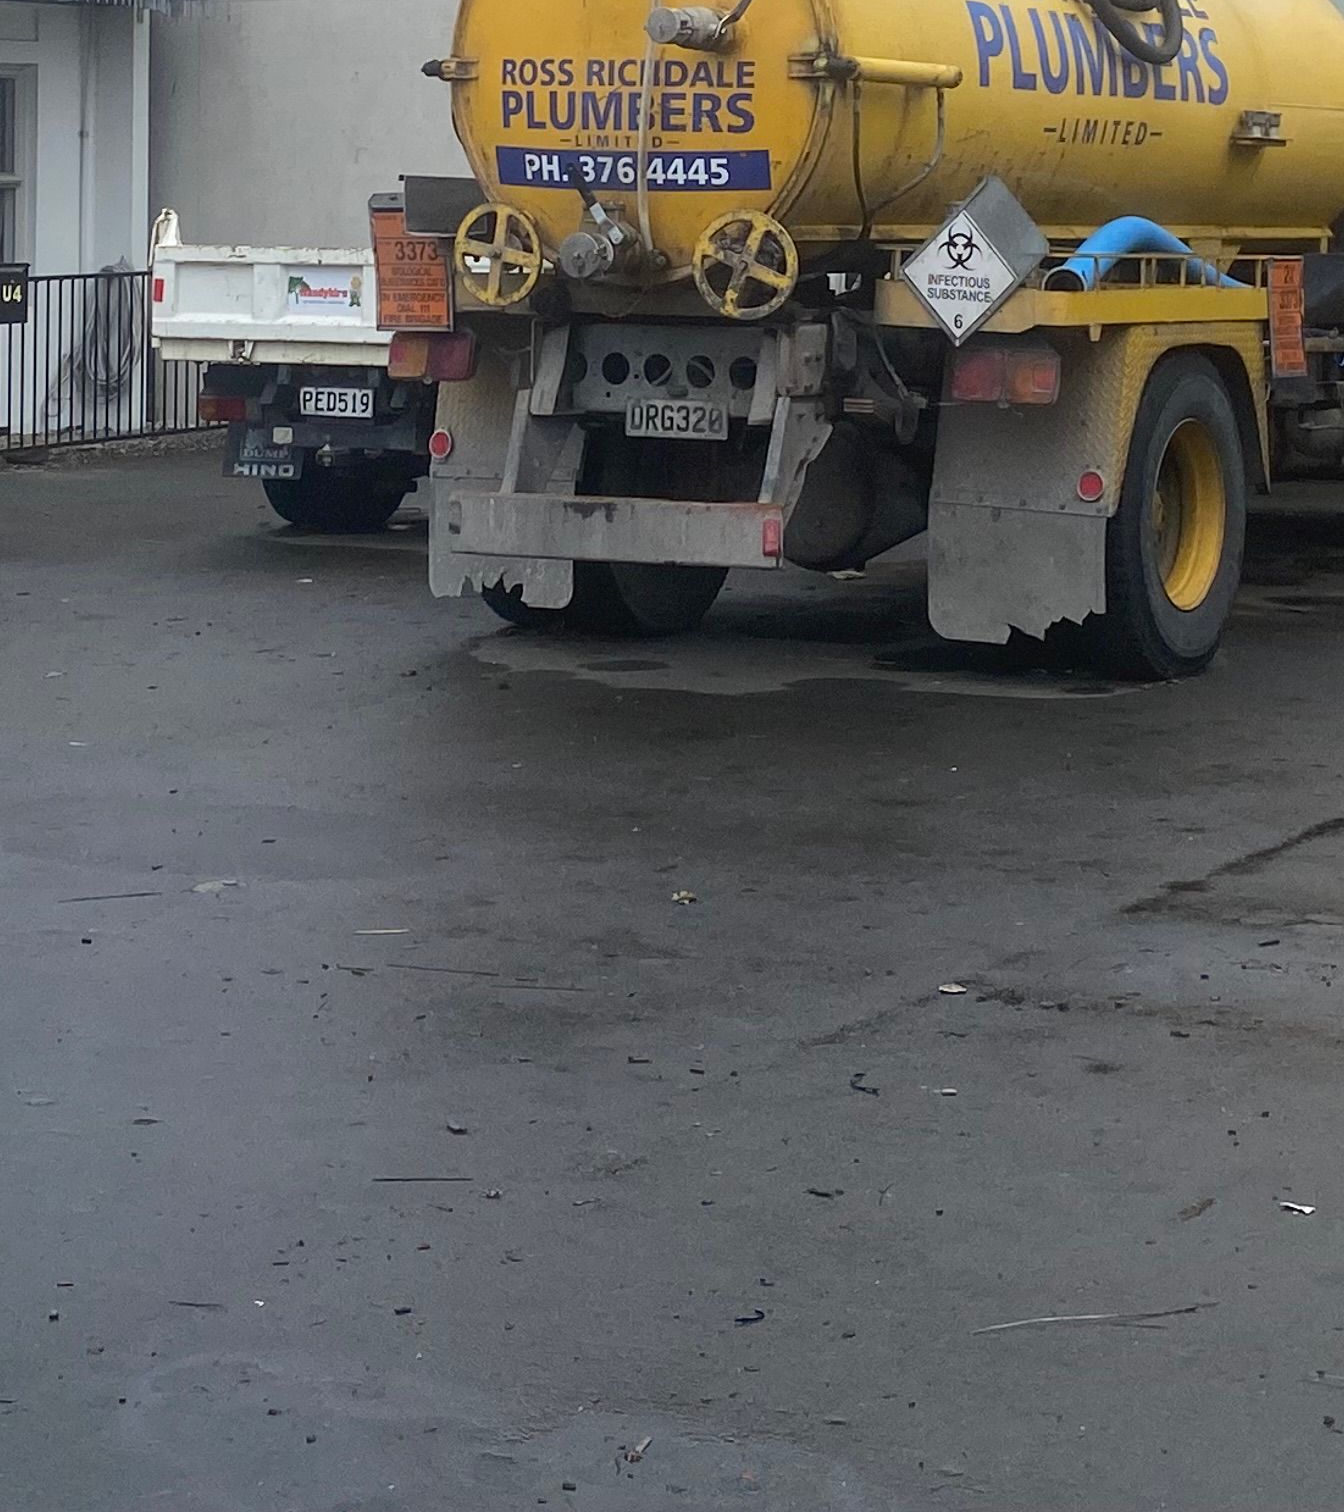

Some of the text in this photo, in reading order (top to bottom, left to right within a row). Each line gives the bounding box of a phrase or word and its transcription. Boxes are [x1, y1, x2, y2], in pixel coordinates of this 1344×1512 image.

[502, 59, 574, 86] ROSS
[502, 90, 755, 133] PLUMBERS
[524, 153, 569, 182] PH.
[646, 158, 730, 185] 4445
[394, 240, 439, 261] 3373
[928, 274, 990, 288] INFECTIOUS
[2, 285, 23, 303] U4
[927, 288, 992, 303] SUBSTANCE
[953, 314, 963, 329] 6
[303, 391, 370, 413] PED519
[233, 463, 295, 477] HINO
